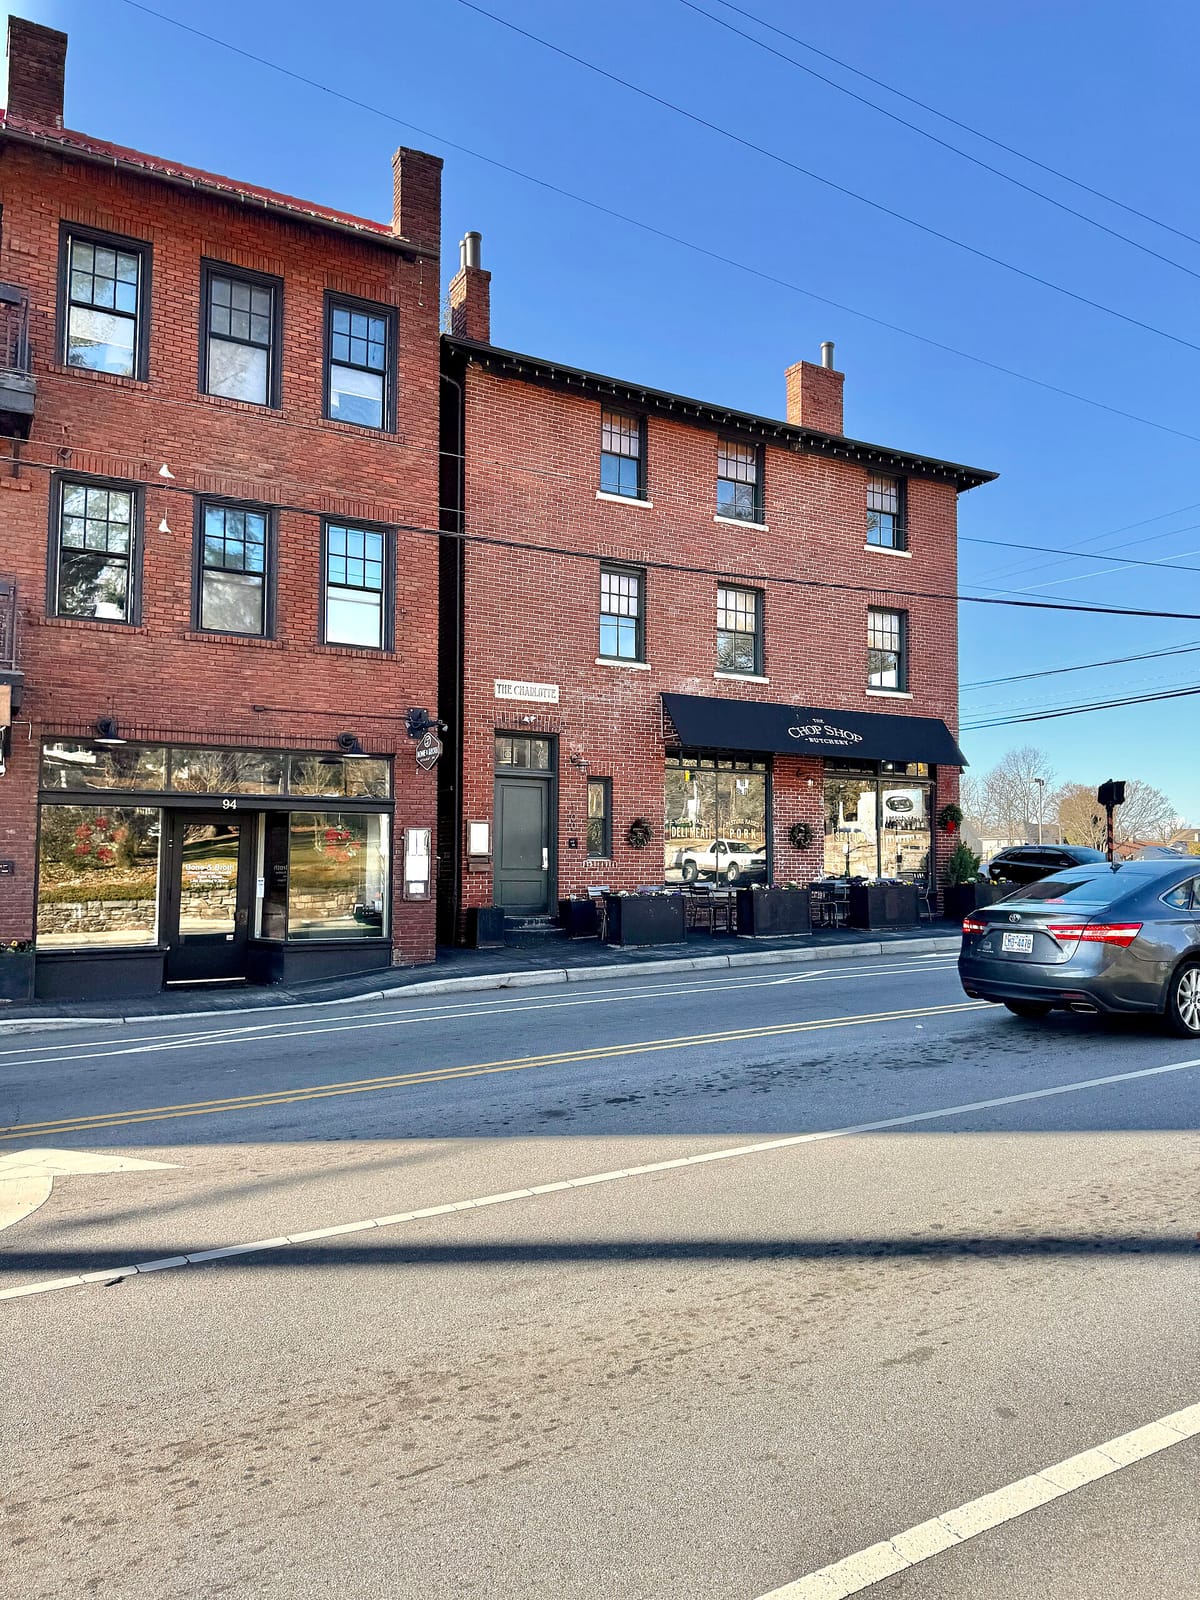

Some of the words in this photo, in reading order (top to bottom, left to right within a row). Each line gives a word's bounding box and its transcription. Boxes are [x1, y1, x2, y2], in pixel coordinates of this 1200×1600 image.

[496, 683, 513, 695] THE
[513, 685, 557, 699] CHARLOTTE
[787, 725, 822, 738] CHOP
[823, 725, 863, 743] SHOP
[222, 798, 237, 810] 94
[671, 826, 688, 838] DELI
[689, 826, 711, 839] MEAT
[729, 827, 757, 839] PORK
